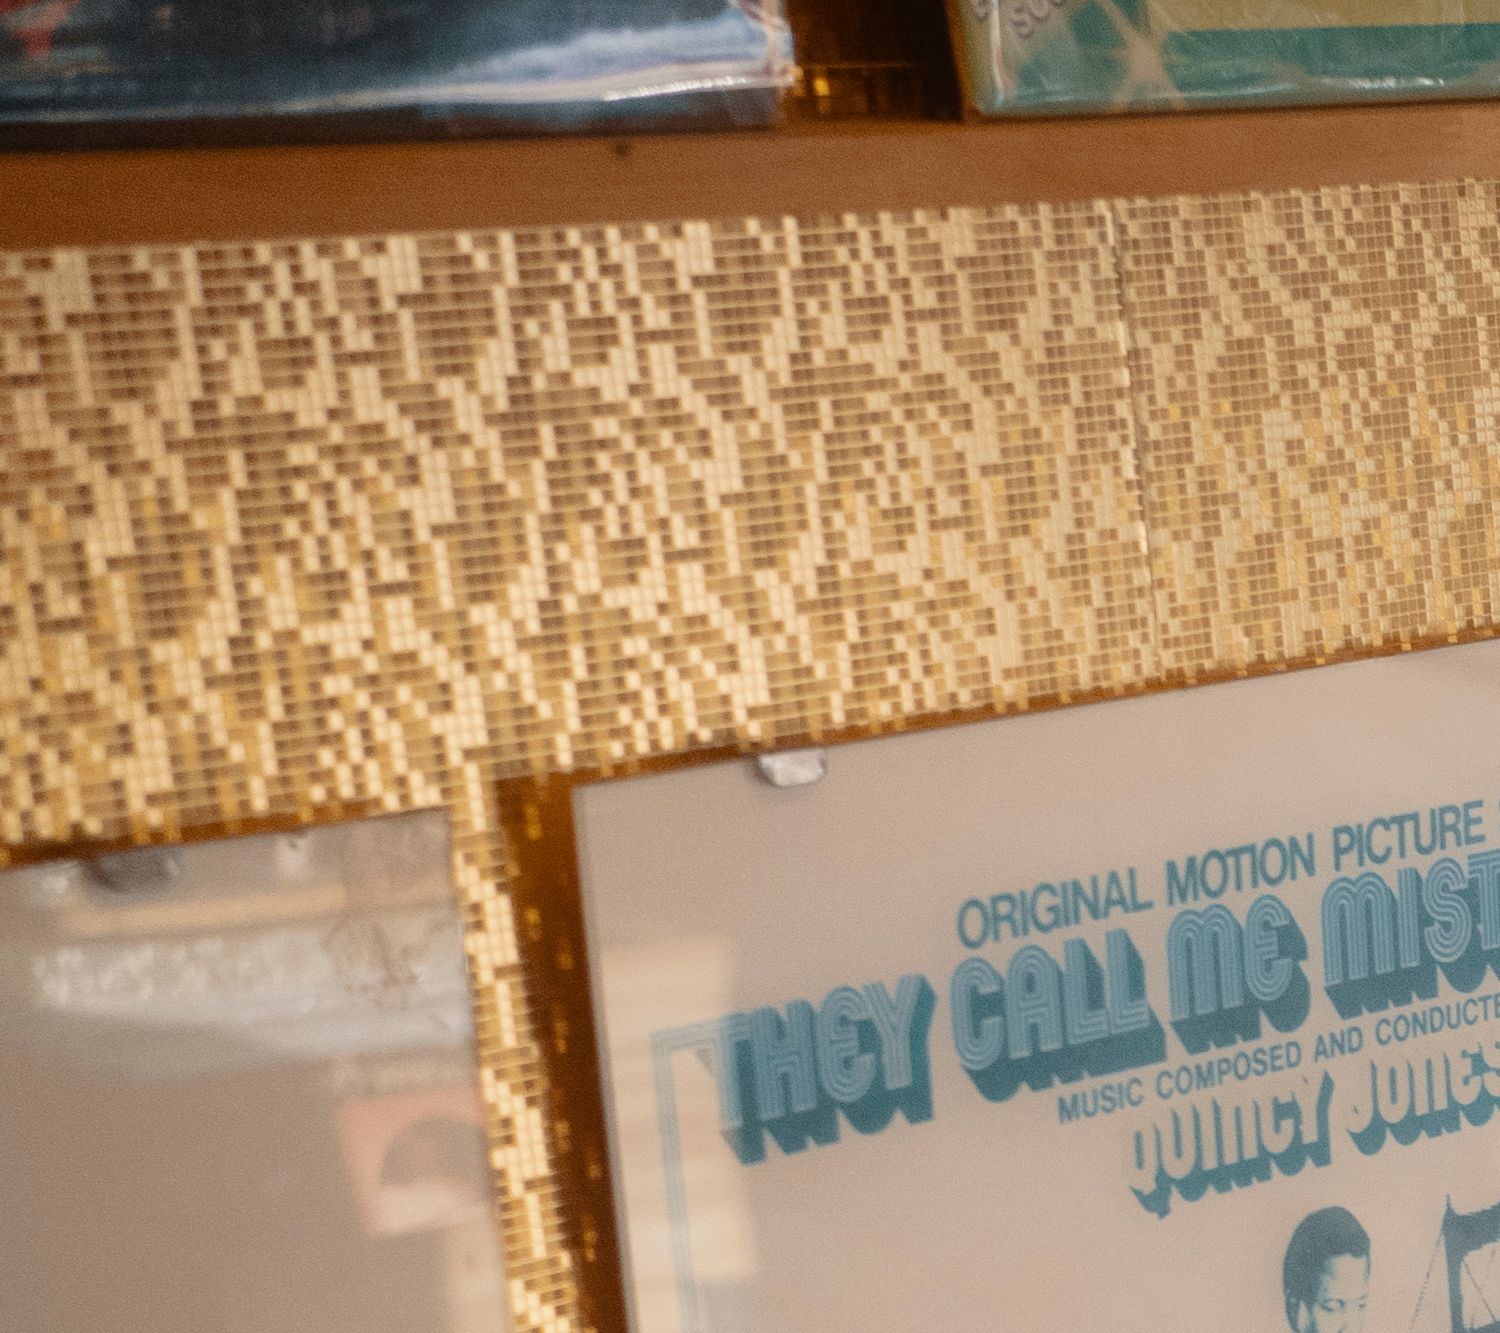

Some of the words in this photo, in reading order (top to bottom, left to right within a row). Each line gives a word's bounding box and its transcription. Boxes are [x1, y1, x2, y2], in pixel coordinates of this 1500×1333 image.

[955, 867, 1154, 949] ORIGINAL
[1166, 833, 1316, 907] MOTION
[1332, 799, 1486, 872] PICTURE
[698, 973, 938, 1166] THEY
[949, 928, 1168, 1103] CALL
[1166, 894, 1311, 1056] ME
[1057, 1078, 1145, 1124] MUSIC
[1155, 1040, 1301, 1101] COMPOSED
[1314, 1026, 1365, 1064] AND
[1130, 1070, 1335, 1219] QUINCY
